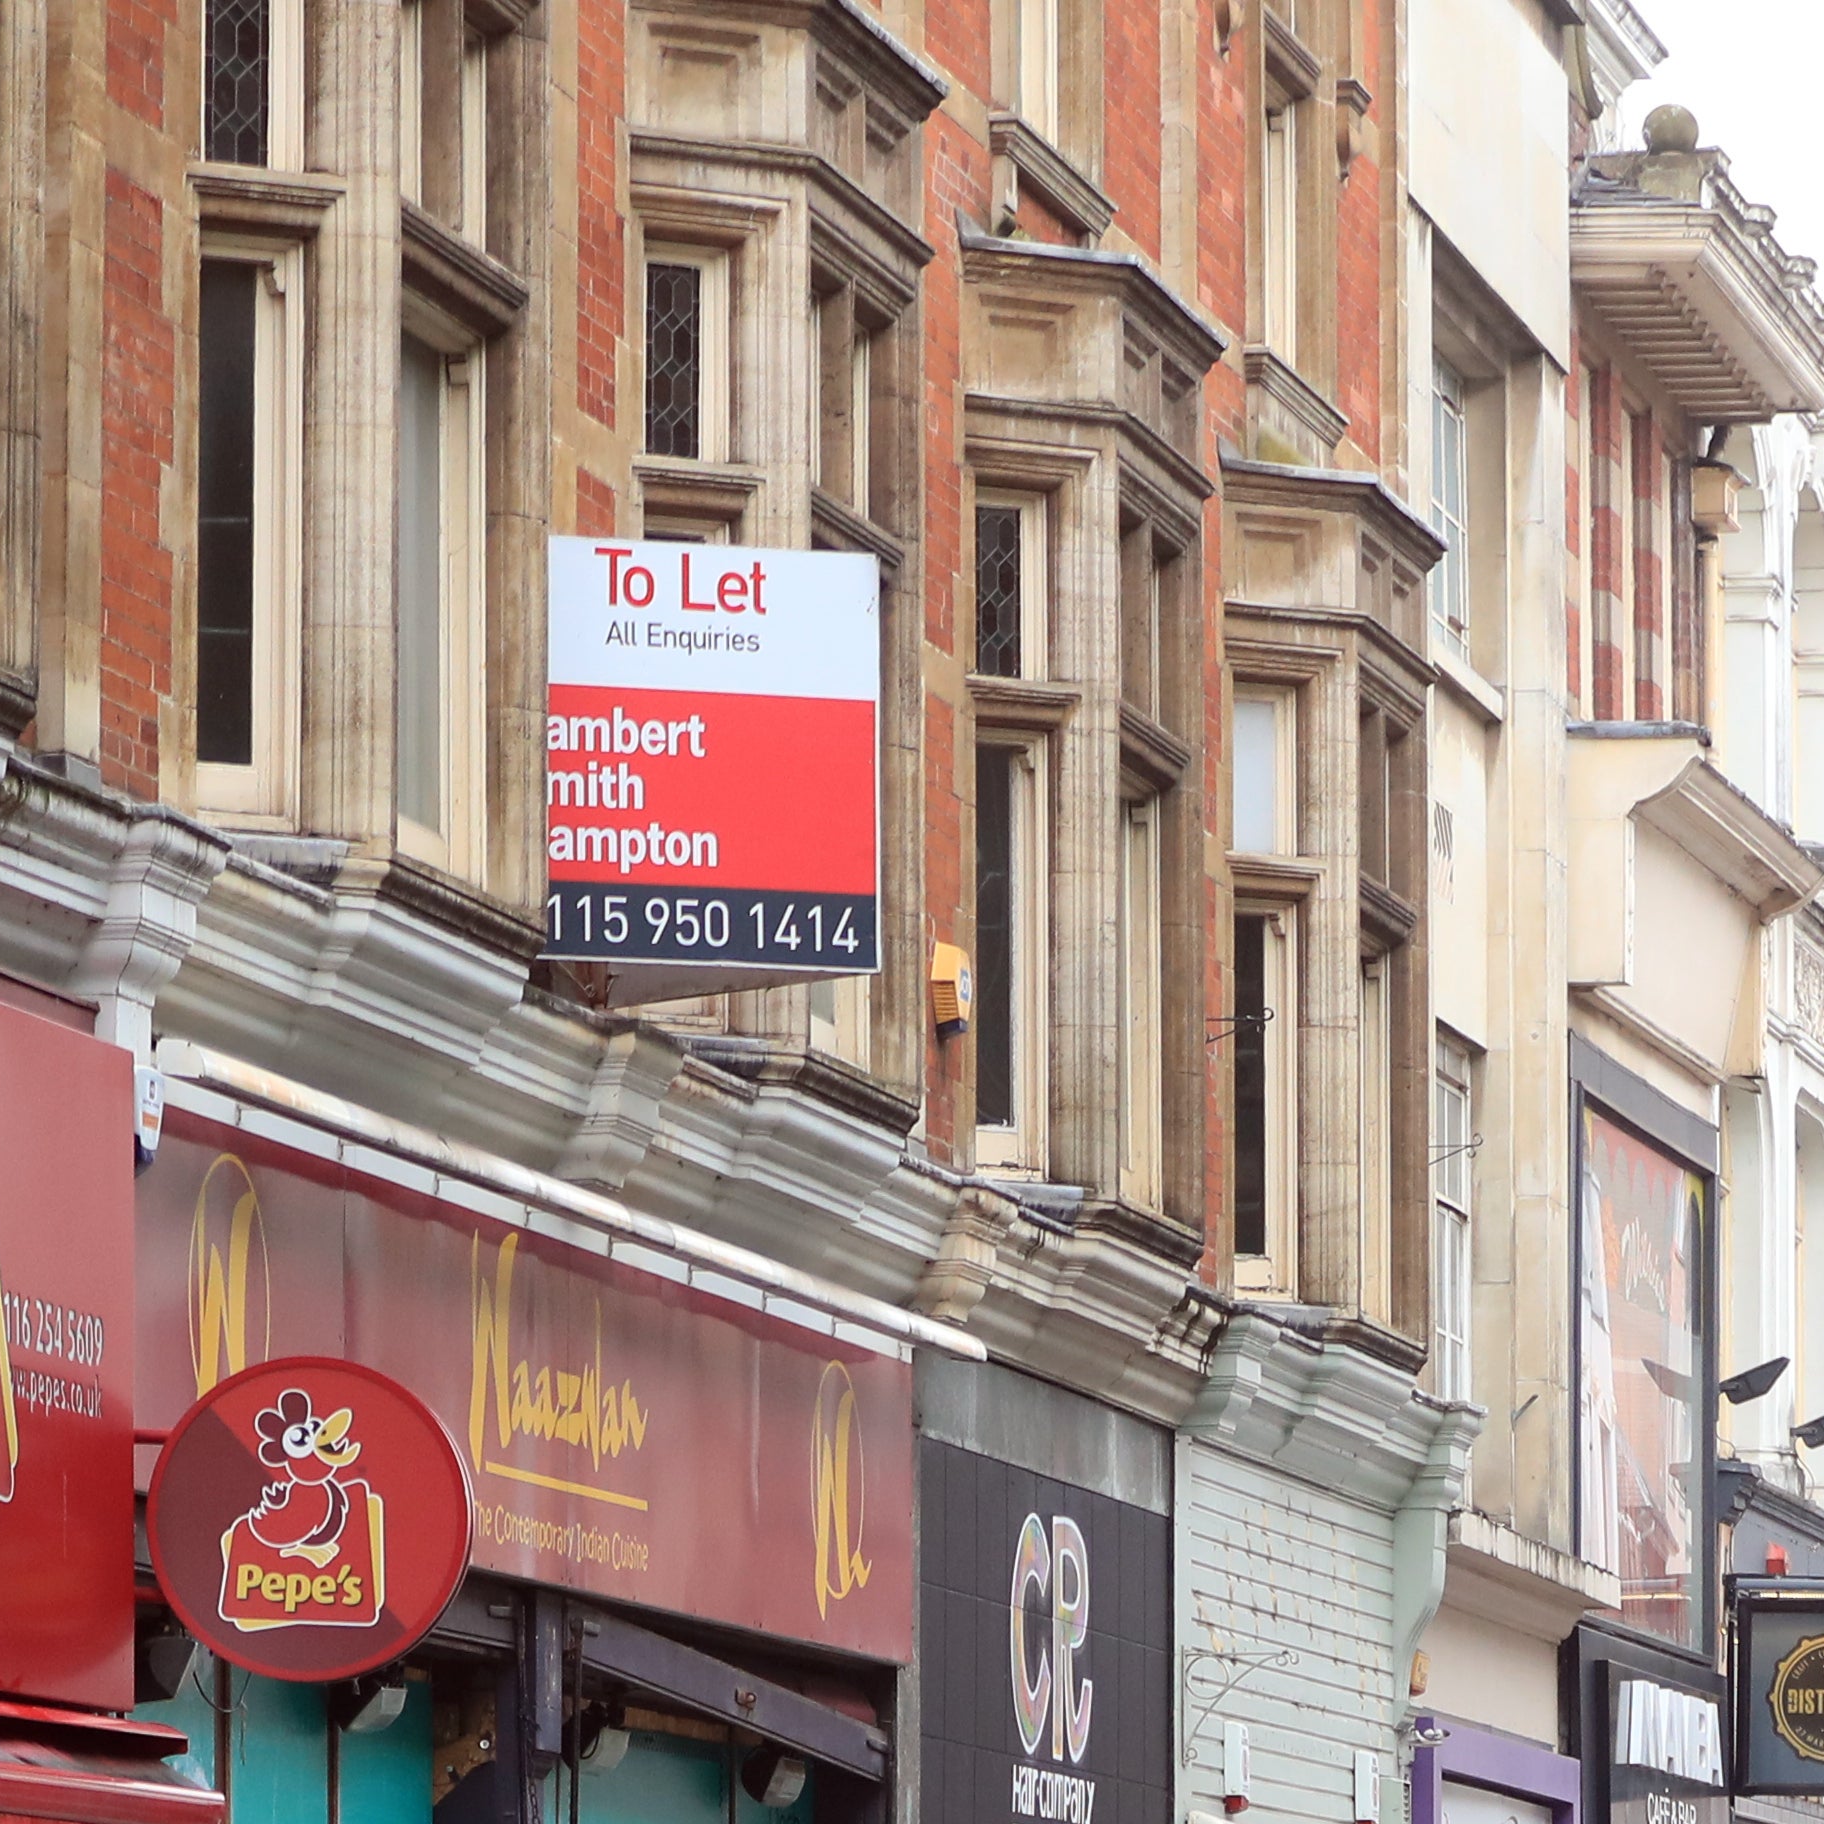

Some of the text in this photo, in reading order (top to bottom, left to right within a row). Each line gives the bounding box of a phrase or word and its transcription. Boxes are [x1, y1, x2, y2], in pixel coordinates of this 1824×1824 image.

[594, 547, 766, 615] To Let
[606, 620, 760, 655] All Enquiries
[547, 706, 706, 758] ambert
[547, 762, 644, 810] mith
[549, 822, 718, 874] ampton
[547, 894, 859, 954] 115 950 1414
[36, 1300, 62, 1357] 254
[68, 1310, 103, 1367] 5609
[494, 1505, 574, 1558] Contemporary
[576, 1523, 610, 1563] Indian
[612, 1532, 649, 1571] Cuisine
[236, 1563, 362, 1612] Pepe's
